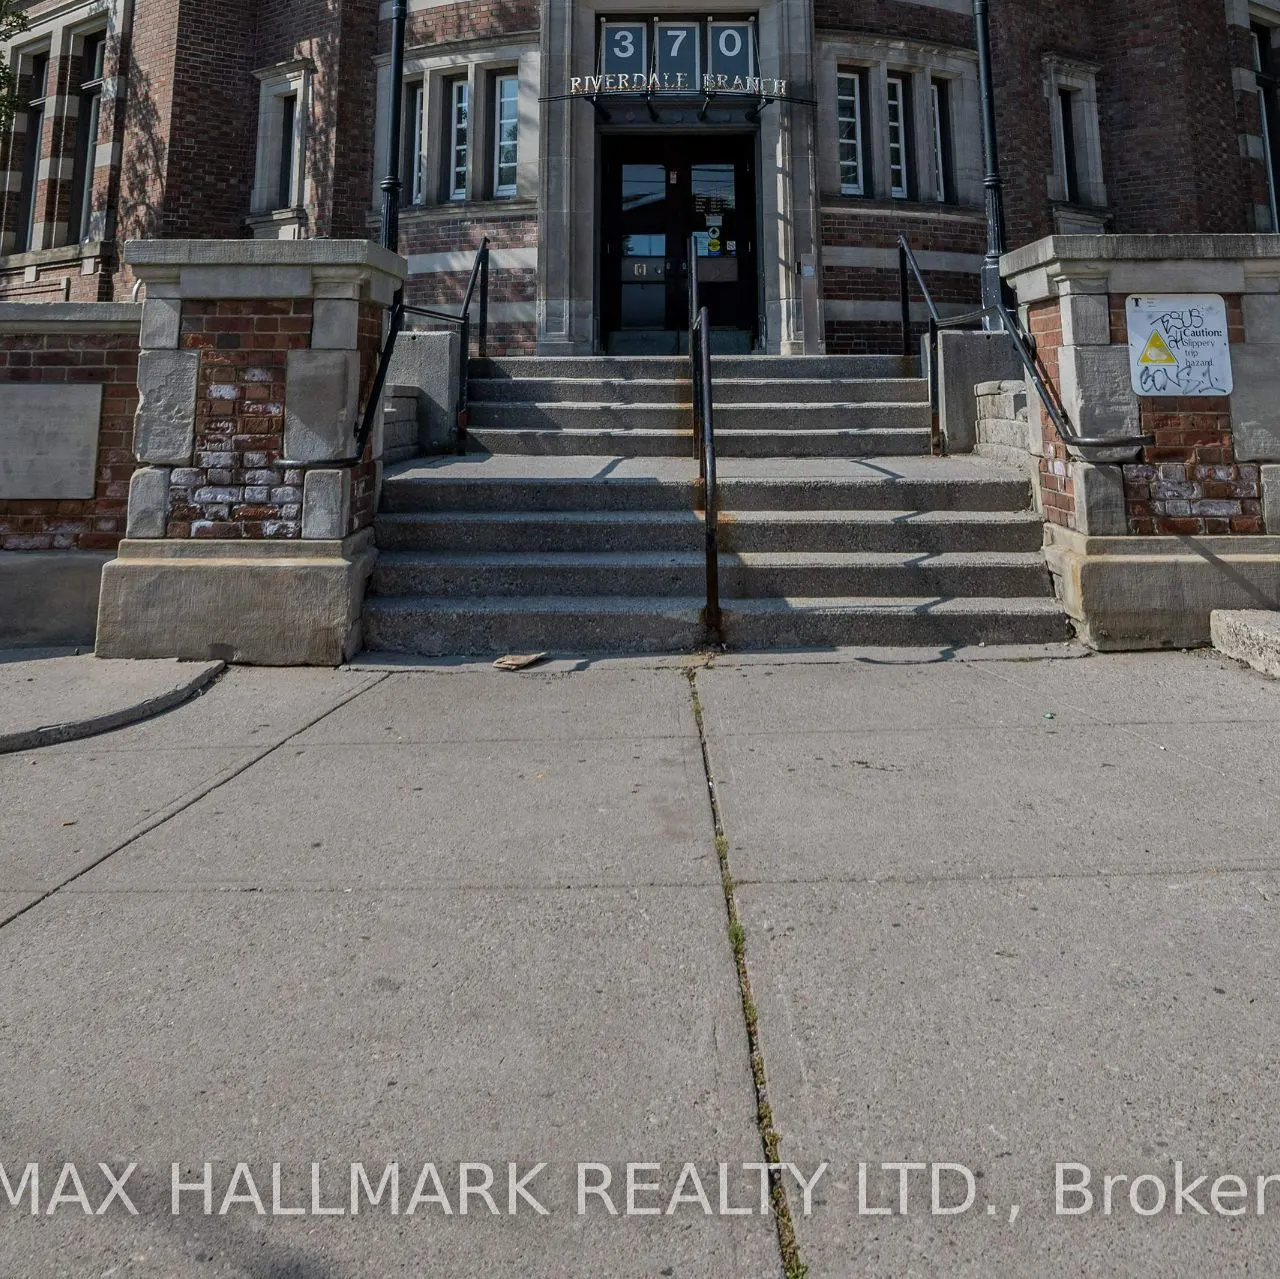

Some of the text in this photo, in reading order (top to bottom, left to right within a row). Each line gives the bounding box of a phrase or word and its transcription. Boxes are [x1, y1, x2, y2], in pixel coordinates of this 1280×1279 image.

[570, 72, 787, 95] RIVERDALE BRANCH
[1183, 328, 1223, 337] Caution:
